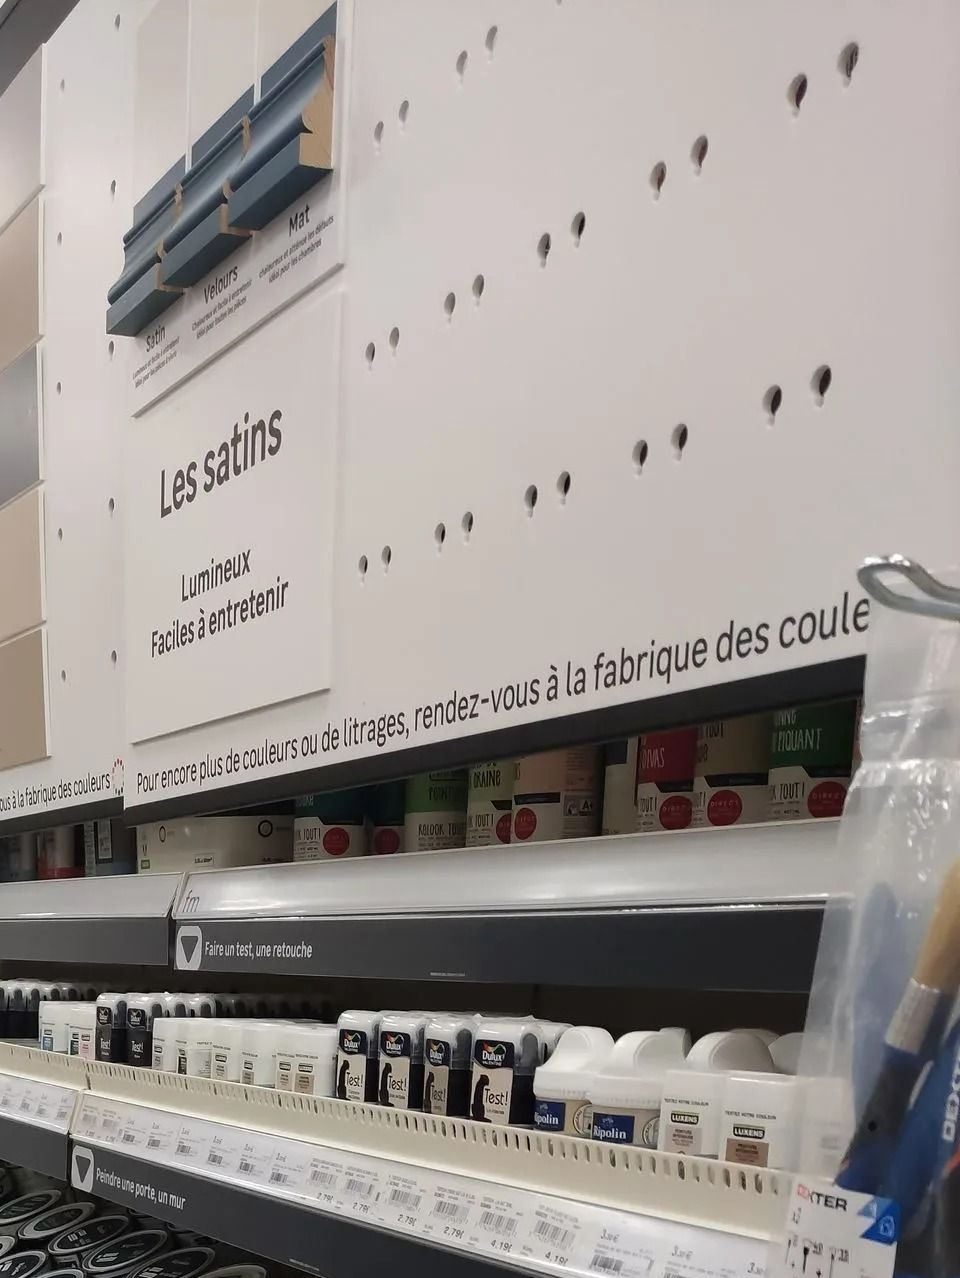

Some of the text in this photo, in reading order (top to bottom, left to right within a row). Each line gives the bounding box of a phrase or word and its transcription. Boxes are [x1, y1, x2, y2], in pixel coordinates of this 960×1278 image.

[289, 204, 310, 237] Mat
[204, 266, 238, 304] Velours
[146, 324, 166, 352] Satin
[160, 409, 283, 518] Les satins
[182, 549, 251, 602] Lumineux
[151, 576, 289, 658] Faciles à entretenir
[137, 591, 871, 794] Pour encore plus de couleurs ou de litrages, rendez-vous à la fabrique des coule
[777, 728, 823, 752] PIQUANT
[25, 784, 56, 807] fabrique
[58, 779, 72, 799] des
[73, 772, 111, 796] couleurs
[205, 941, 313, 959] Faire un test, une retouche
[482, 1051, 505, 1062] Dulux
[346, 1072, 363, 1088] Test!
[388, 1075, 407, 1091] Test!
[485, 1088, 509, 1107] Test!
[534, 1112, 559, 1126] ipolin
[672, 1113, 698, 1125] LUXENS
[593, 1125, 627, 1143] Ripolin
[733, 1126, 765, 1139] LUXENS
[96, 1167, 187, 1211] Peindre une porte, un mur
